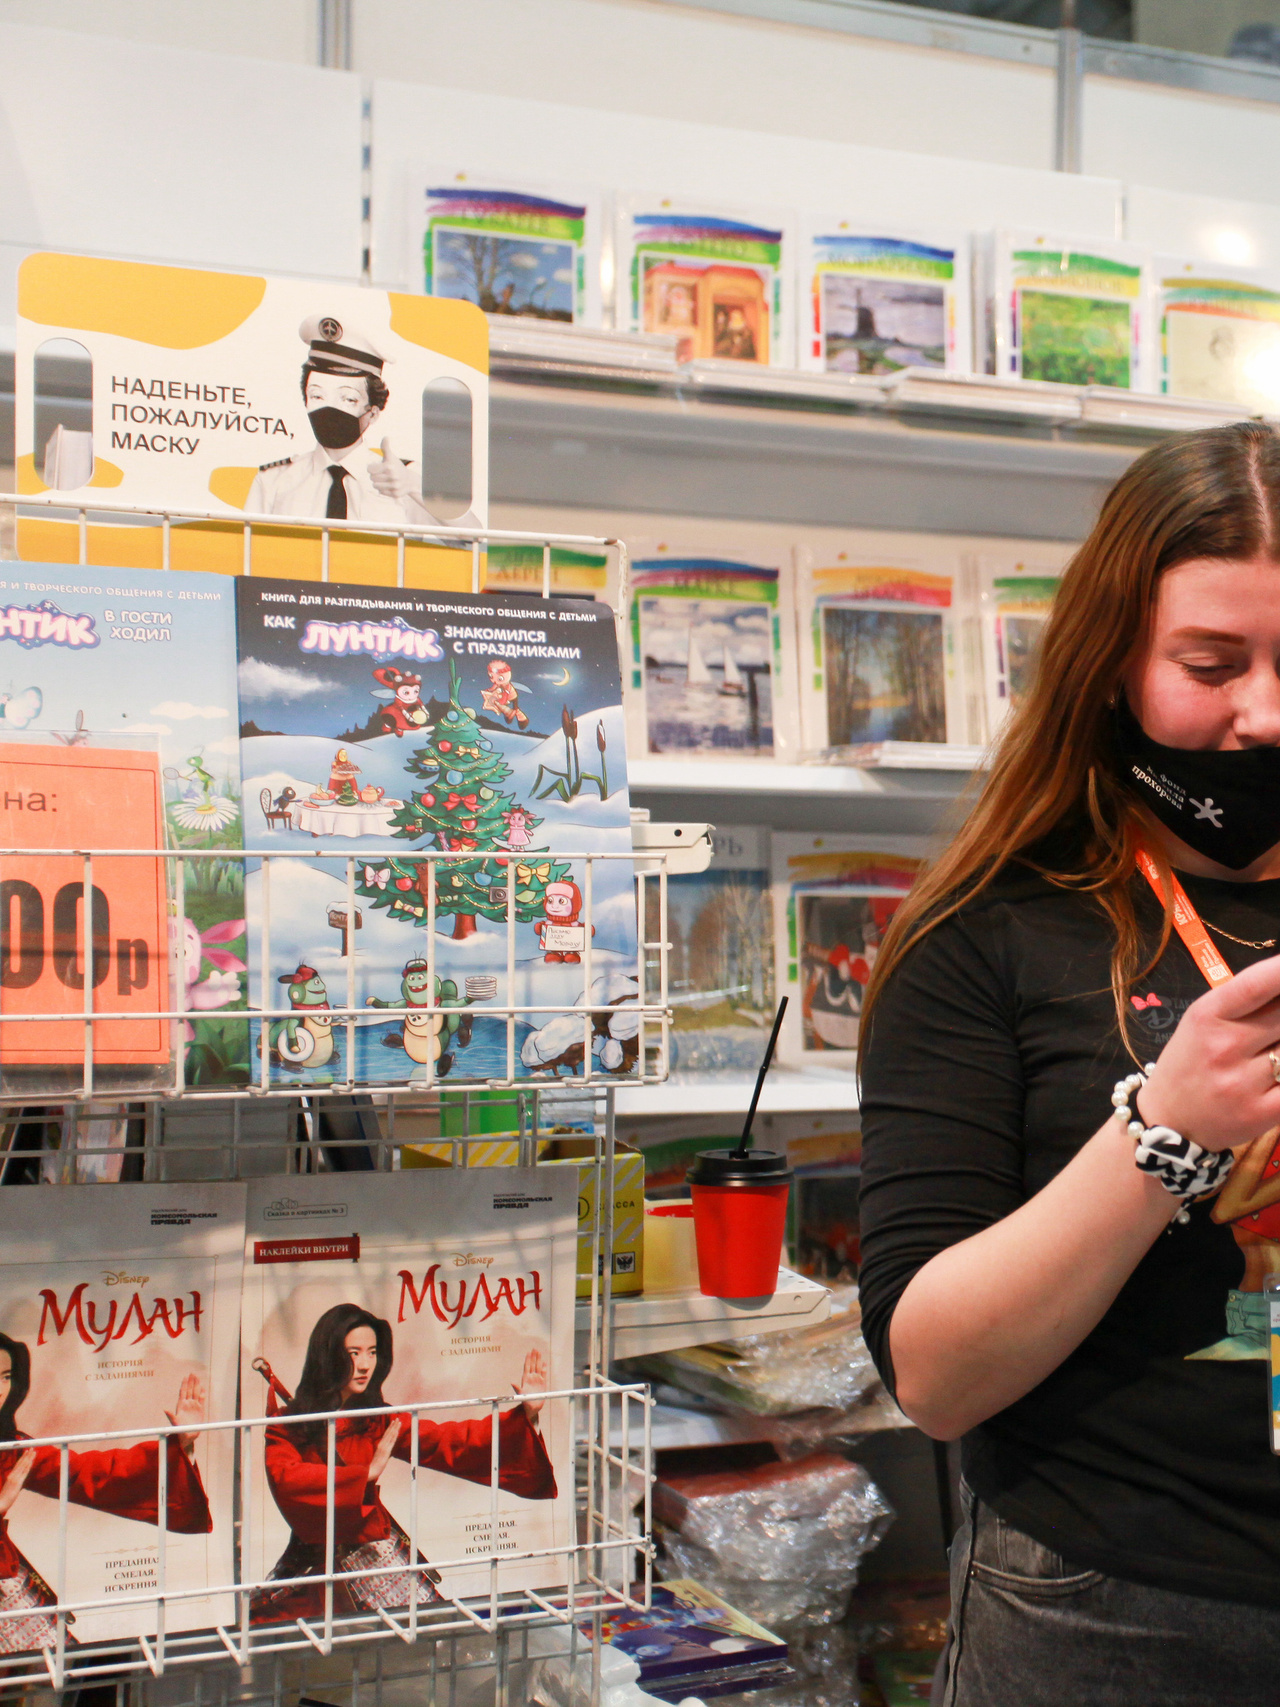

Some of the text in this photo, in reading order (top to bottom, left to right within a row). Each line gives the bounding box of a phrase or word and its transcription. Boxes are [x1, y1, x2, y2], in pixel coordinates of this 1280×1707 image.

[110, 375, 252, 409] НАДЕНЬТЕ,
[110, 401, 295, 438] ПОЖАЛУЙСТА,
[110, 430, 200, 455] МАСКУ
[11, 582, 20, 590] И
[24, 582, 103, 595] ТВОРЧЕСКОГО
[106, 588, 164, 599] ОБЩЕНИЯ
[167, 590, 174, 599] С
[178, 591, 222, 601] ДЕТЬМИ
[261, 592, 597, 622] КНИГА ДЛЯ РАЗГЛЯДЫВАНИЯ И ТВОРЧЕСКОГО ОБЩЕНИЯ С ДЕТЬМИ
[104, 610, 116, 623] В
[121, 610, 172, 626] ГОСТИ
[110, 626, 172, 643] ХОДИЛ
[263, 614, 547, 660] КАК ЛУНТИК ЗНАКОМИЛСЯ
[453, 641, 581, 660] С ПРАЗДНИКАМИ
[259, 1244, 349, 1257] НАКЛЕЙКИ ВНУТРИ
[449, 1252, 494, 1269] Disney
[101, 1270, 150, 1288] Disney
[450, 1336, 491, 1345] ИСТОРИЯ
[448, 1346, 502, 1356] ЗАДАНИЯМИ
[97, 1359, 143, 1370] ИСТОРИЯ
[93, 1370, 154, 1381] ЗАДАНИЯМИ
[465, 1520, 518, 1532] ПРЕДАНАЯ.
[473, 1532, 510, 1542] СМЕАЯ.
[114, 1569, 156, 1579] СМЕЛАЯ.
[104, 1580, 158, 1593] ИСКРЕННЯ
